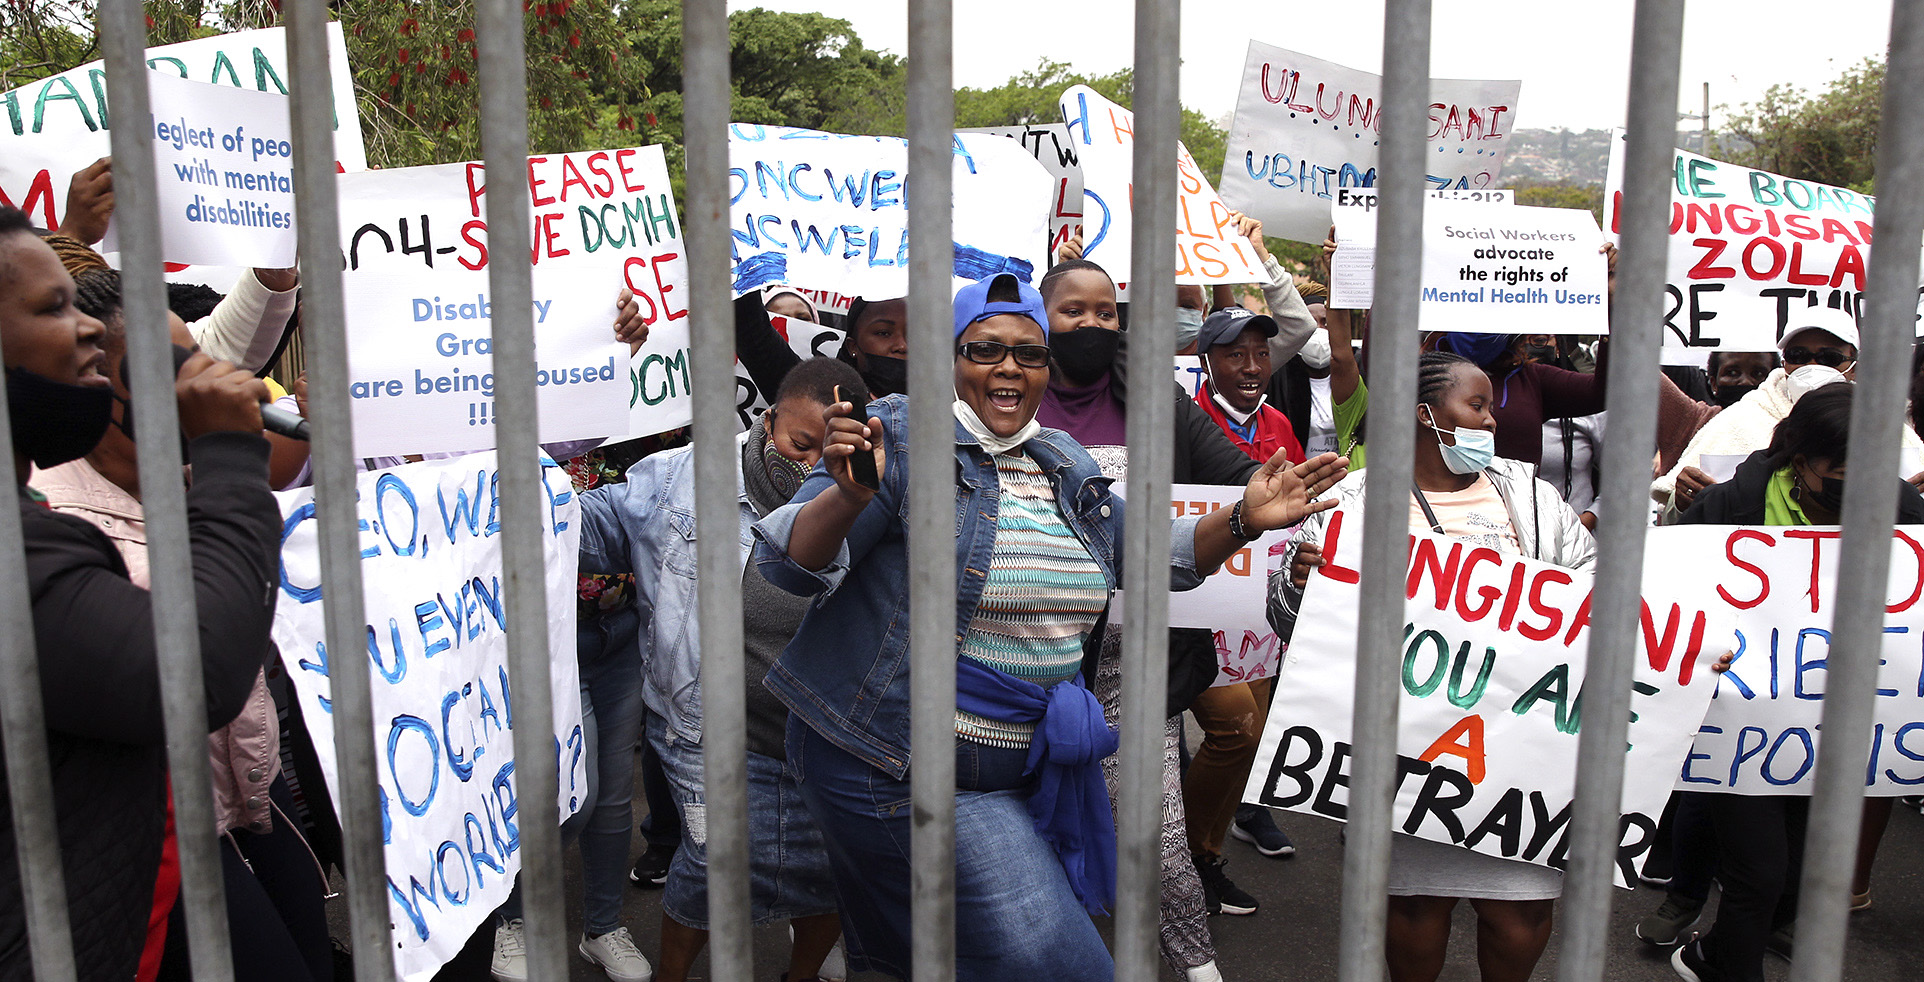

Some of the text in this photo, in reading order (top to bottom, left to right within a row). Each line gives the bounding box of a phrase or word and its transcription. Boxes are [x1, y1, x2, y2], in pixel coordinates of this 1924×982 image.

[1261, 62, 1508, 141] ULUNSANI
[150, 113, 292, 162] eglect of peo
[174, 157, 295, 194] with mental
[466, 149, 645, 216] PEASE
[1749, 171, 1876, 214] BOAR
[186, 195, 291, 229] disabilities
[578, 194, 676, 253] DCMH
[1444, 225, 1576, 242] Social Workers
[1473, 244, 1555, 261] advocate
[1459, 265, 1569, 283] the rights of
[413, 294, 552, 324] Disaby
[1422, 287, 1601, 305] Mental Health Users
[350, 356, 615, 400] are being bused
[1420, 714, 1487, 785] A
